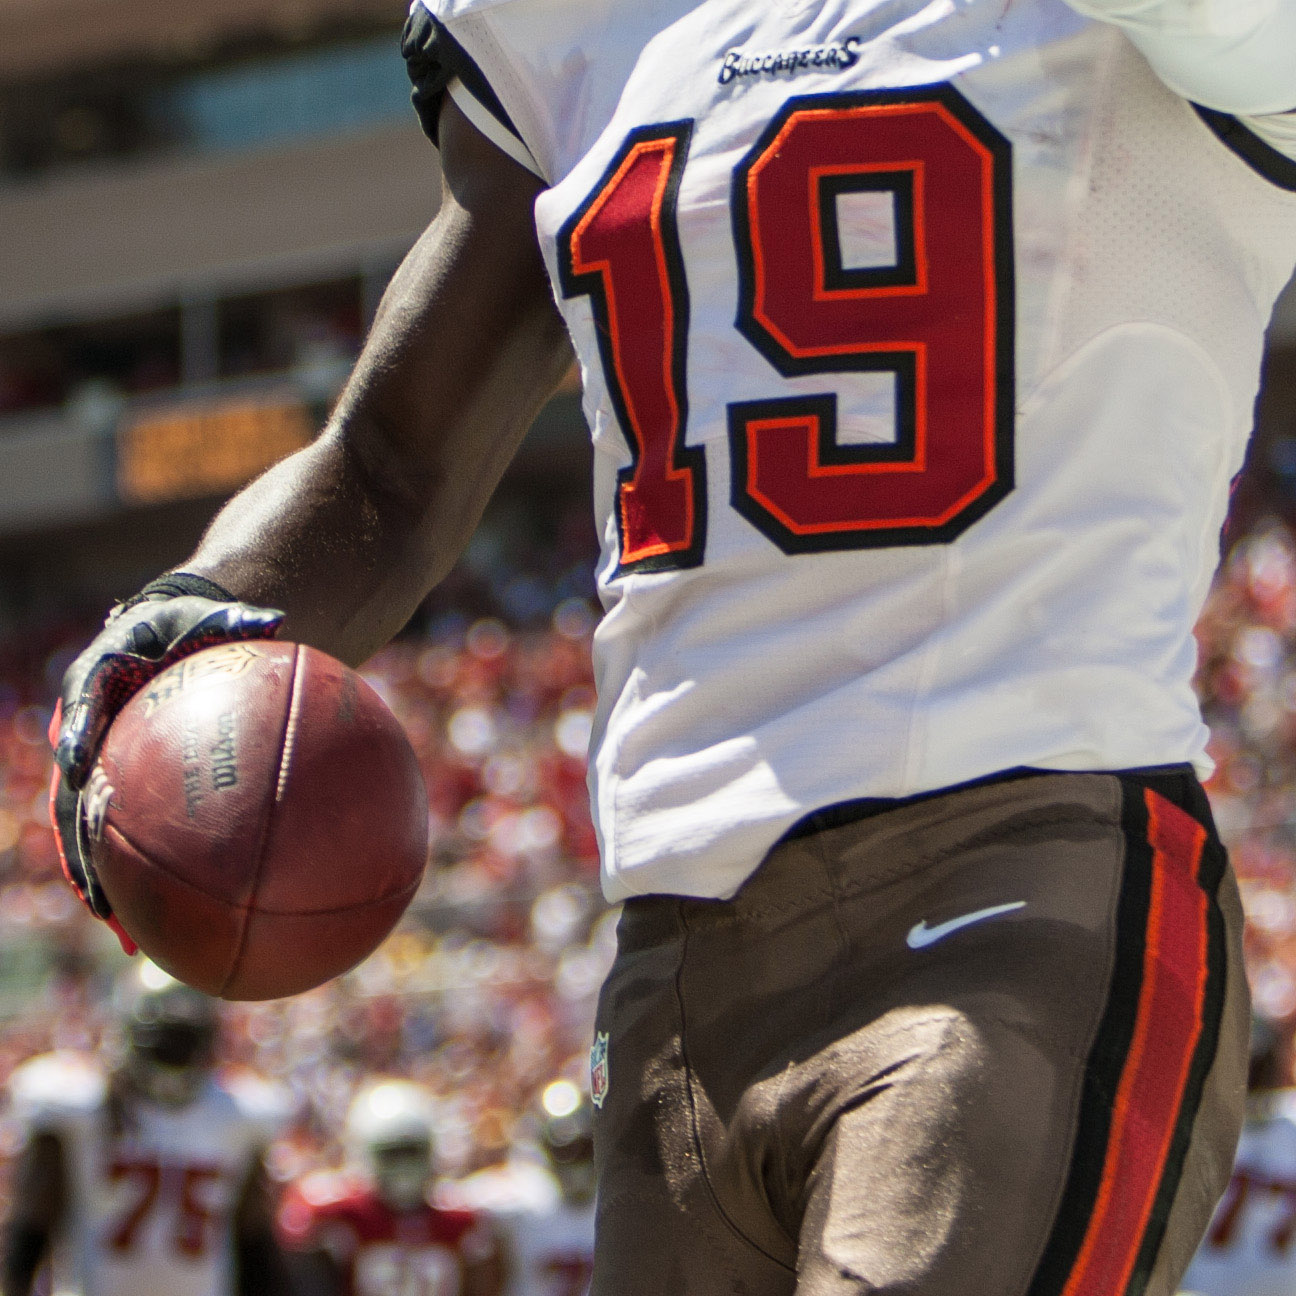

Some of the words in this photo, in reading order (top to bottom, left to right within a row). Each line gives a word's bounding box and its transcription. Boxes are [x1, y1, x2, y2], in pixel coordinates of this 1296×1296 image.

[559, 82, 1016, 572] 19
[211, 711, 237, 791] Wilson
[106, 1158, 226, 1258] 75
